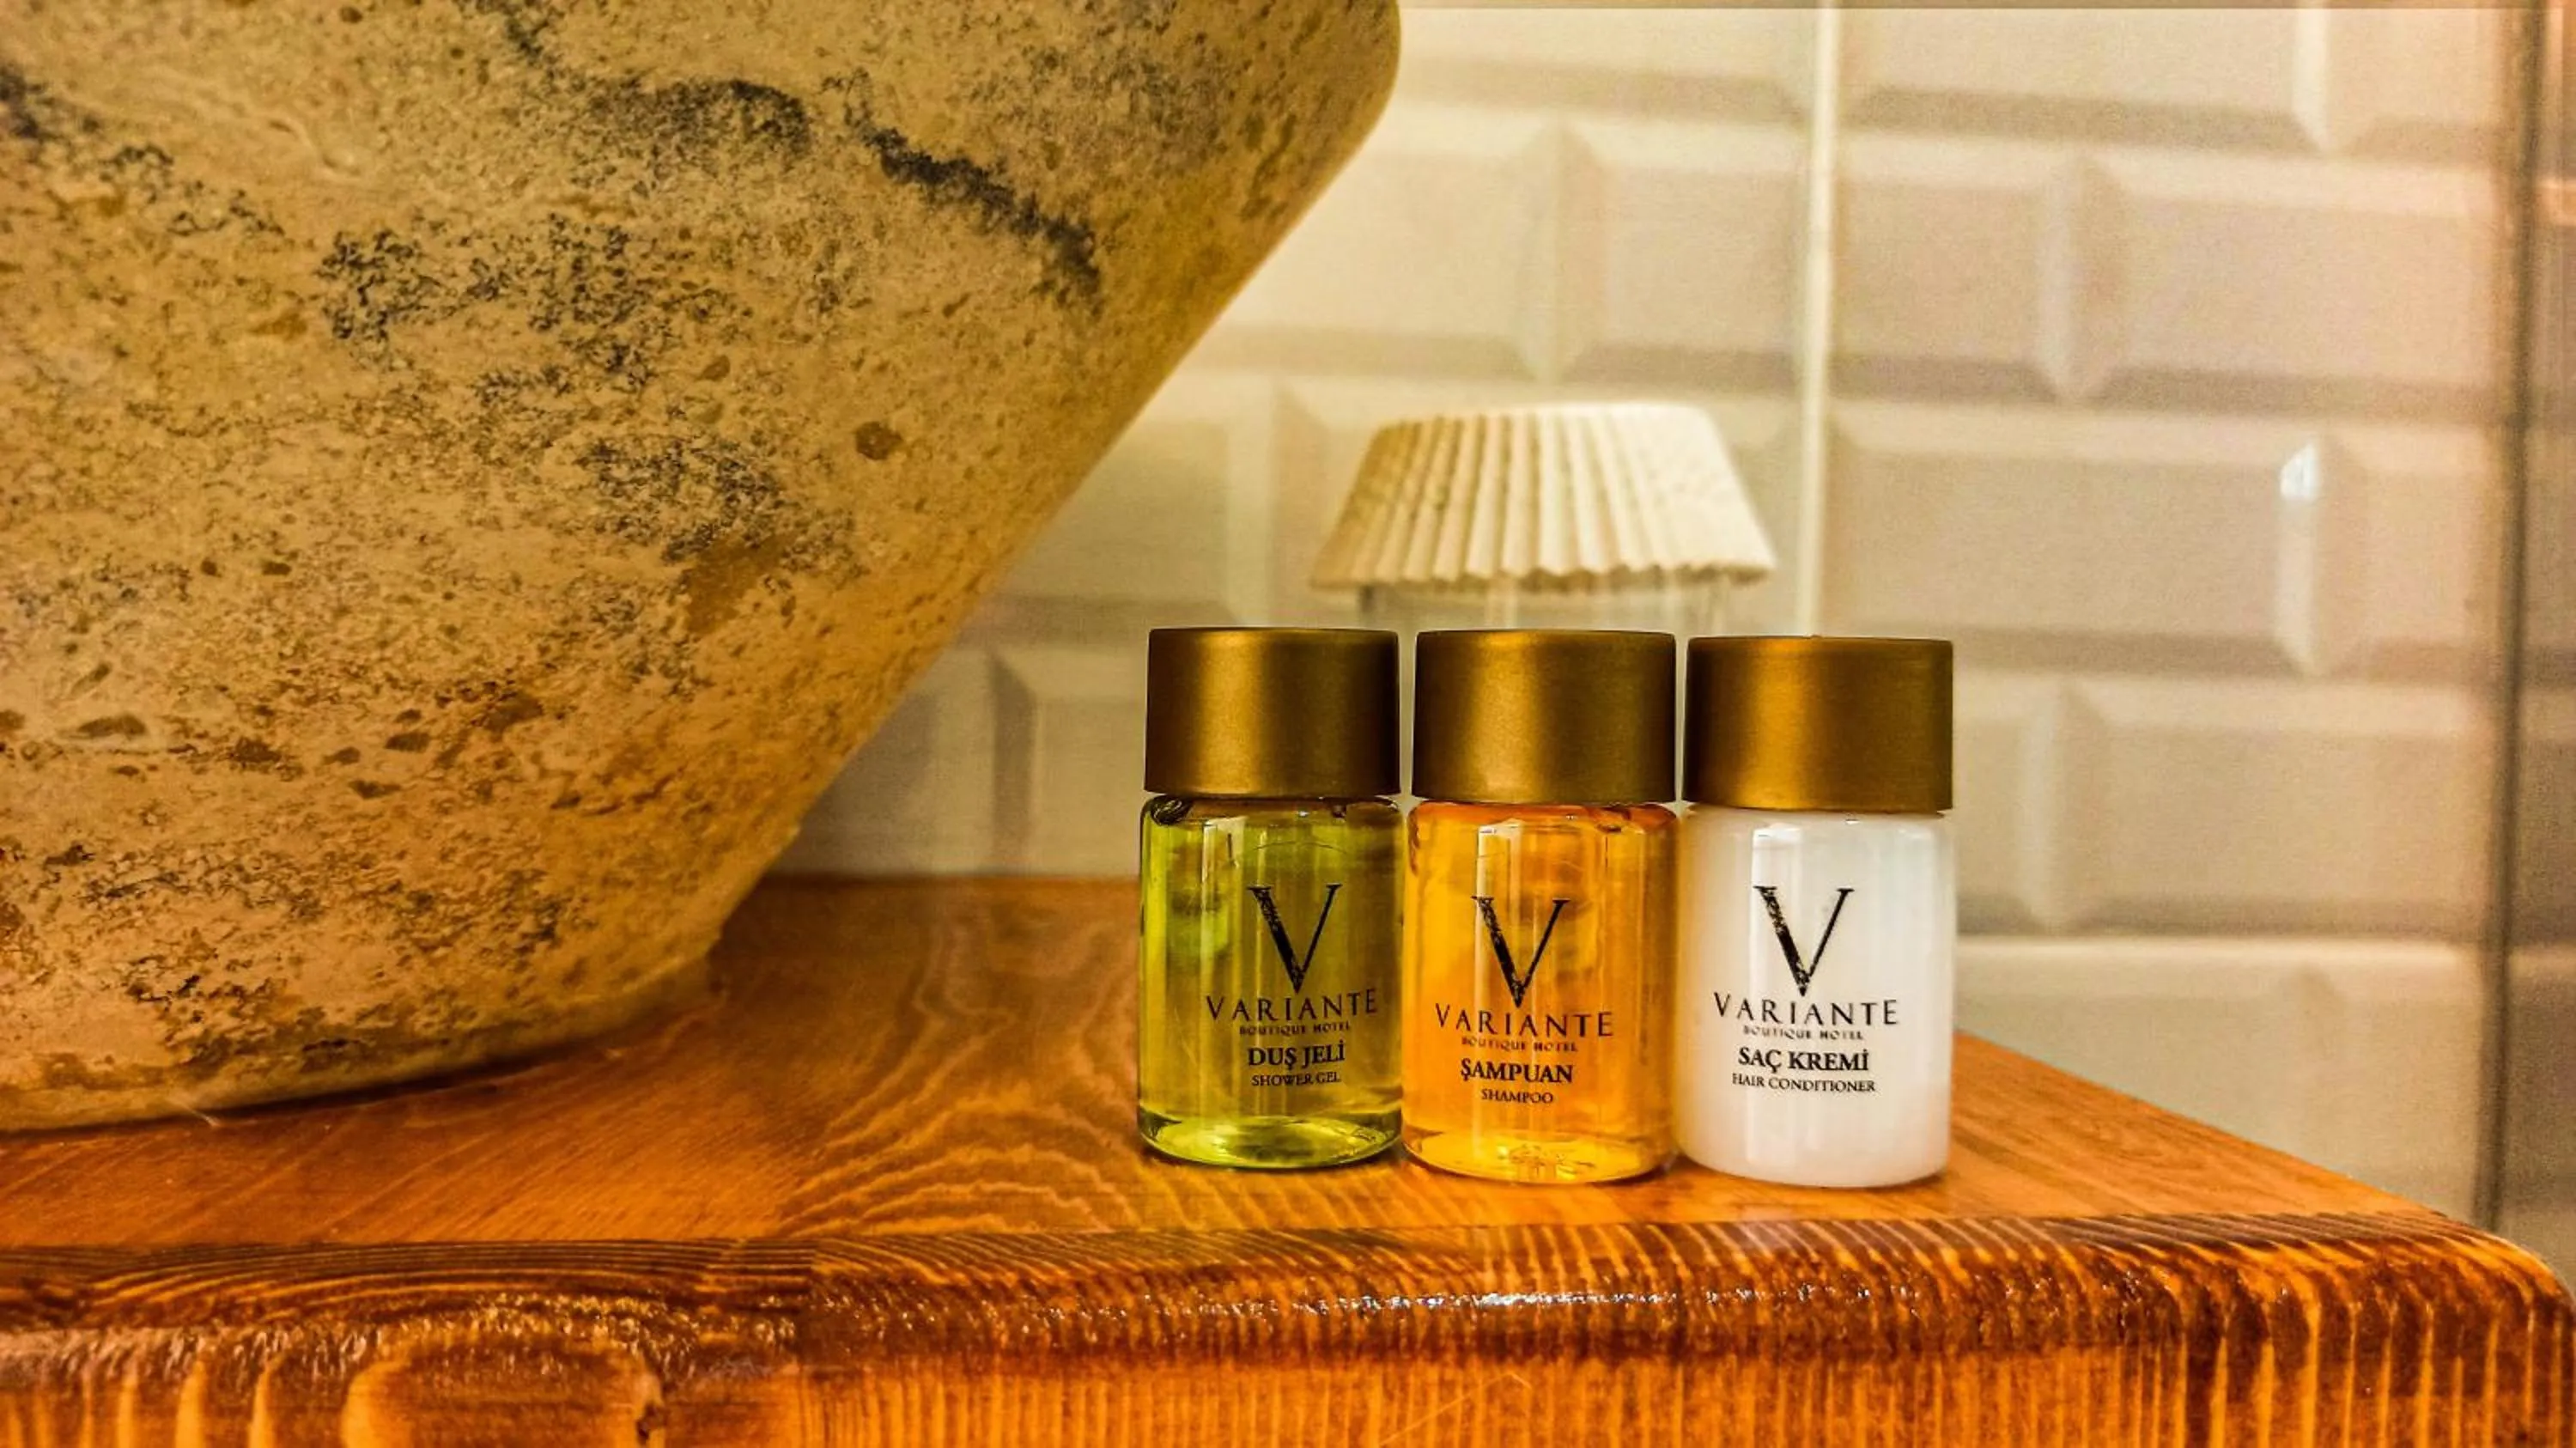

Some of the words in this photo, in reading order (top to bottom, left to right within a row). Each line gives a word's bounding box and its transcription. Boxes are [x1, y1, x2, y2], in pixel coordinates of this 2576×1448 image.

[1248, 883, 1342, 994] V
[1471, 896, 1571, 1008] V
[1753, 885, 1855, 997] V
[1206, 989, 1378, 1020] VARIANTE
[1713, 991, 1900, 1026] VARIANTE
[1239, 1025, 1306, 1037] BOUTIQUE
[1435, 1002, 1615, 1037] VARIANTE
[1744, 1025, 1813, 1039] BOUTIQUE
[1248, 1047, 1297, 1070] DUŞ
[1301, 1039, 1346, 1068] JELİ
[1461, 1037, 1527, 1051] BOUTIQUE
[1461, 1057, 1574, 1083] ŞAMPUAN
[1738, 1046, 1783, 1074] SAÇ
[1788, 1046, 1869, 1071] KREMİ
[1251, 1074, 1313, 1086] SHOWER
[1315, 1071, 1341, 1083] GEL
[1732, 1073, 1765, 1087] HAIR
[1768, 1078, 1876, 1092] CONDITIONER
[1481, 1088, 1554, 1104] SHAMPOO
